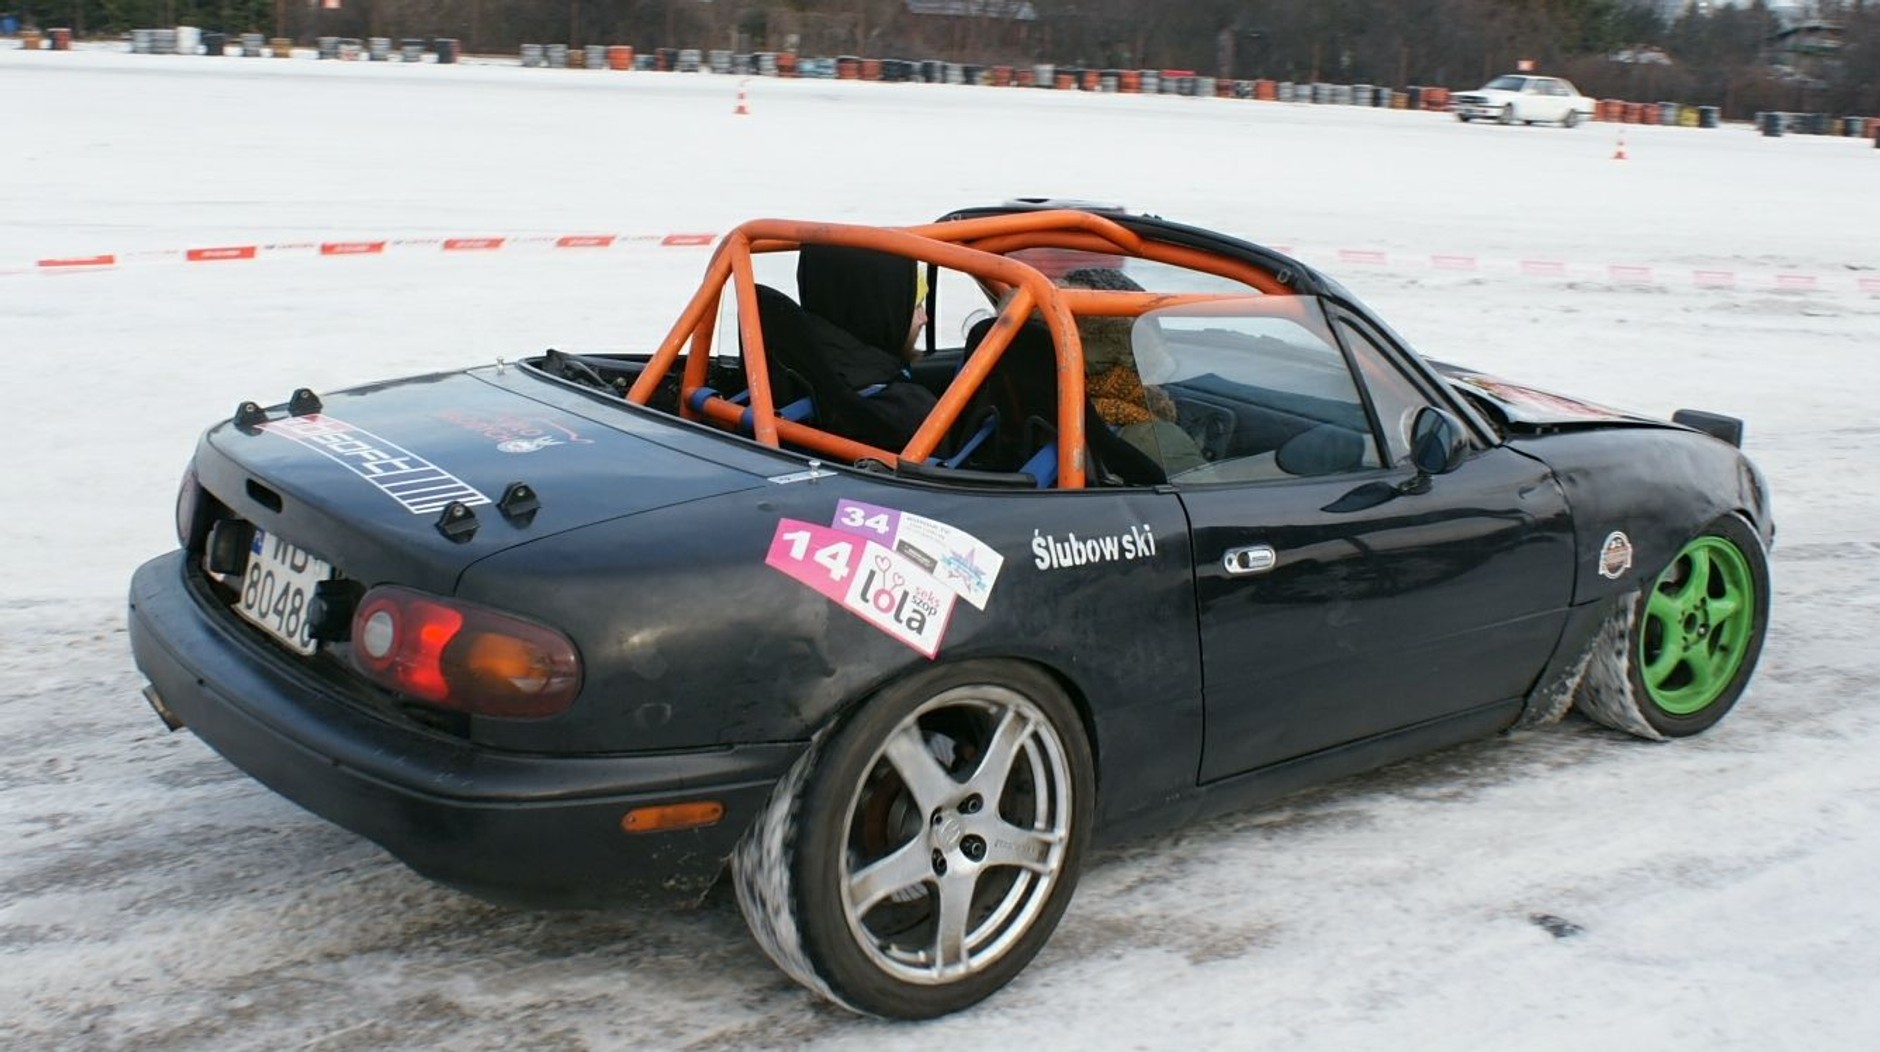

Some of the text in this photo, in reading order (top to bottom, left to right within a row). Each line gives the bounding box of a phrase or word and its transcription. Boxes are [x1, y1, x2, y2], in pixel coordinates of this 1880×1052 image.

[840, 506, 889, 535] 34
[782, 530, 853, 581] 14
[860, 568, 927, 635] lola
[911, 595, 938, 616] szop
